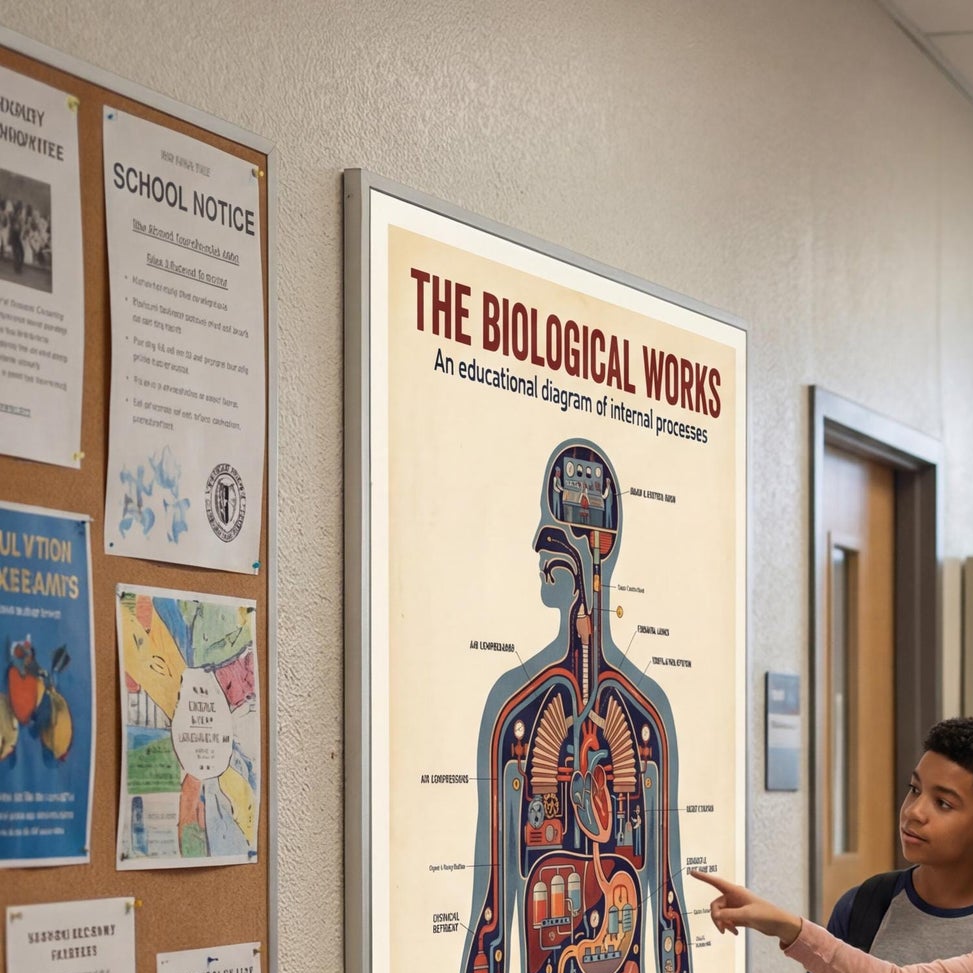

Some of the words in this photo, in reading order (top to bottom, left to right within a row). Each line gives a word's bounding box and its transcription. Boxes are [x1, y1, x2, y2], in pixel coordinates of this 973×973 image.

[113, 162, 188, 212] SCHOOL
[193, 190, 255, 236] NOTICE
[410, 267, 472, 346] THE
[482, 291, 636, 395] BIOLOGICAL
[642, 345, 721, 419] WORKS
[434, 348, 454, 375] An
[458, 358, 538, 398] educational
[541, 378, 592, 412] diagram
[596, 395, 608, 416] of
[610, 398, 653, 429] internal
[656, 415, 708, 443] processes
